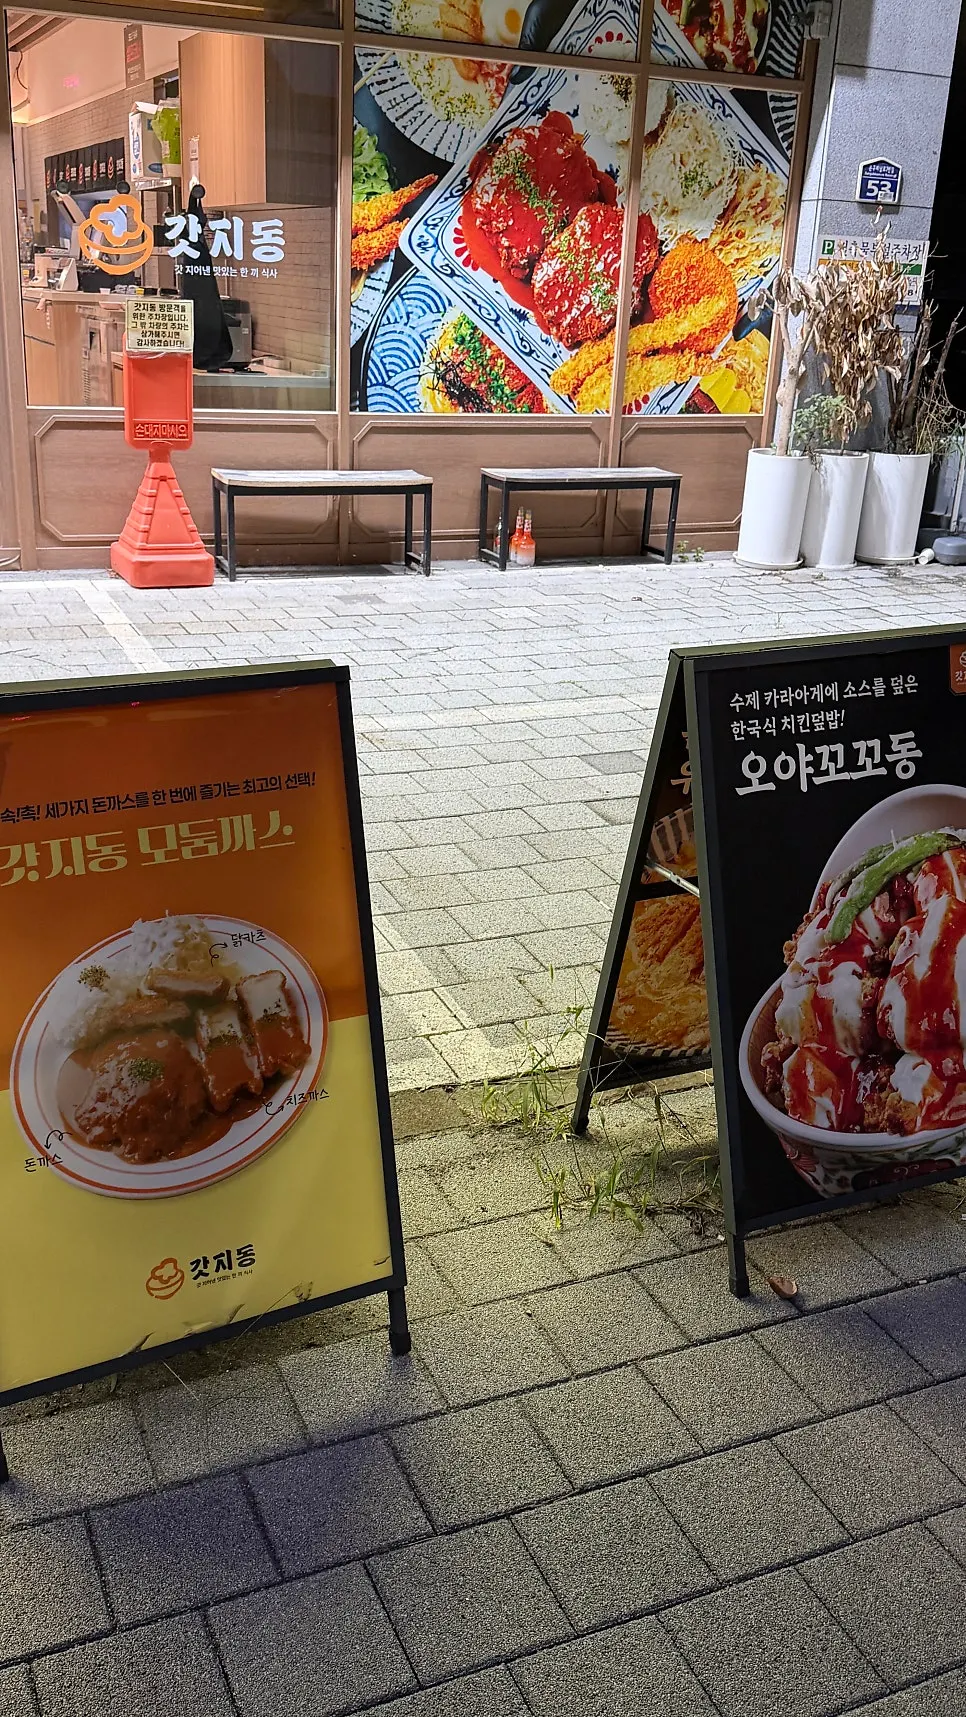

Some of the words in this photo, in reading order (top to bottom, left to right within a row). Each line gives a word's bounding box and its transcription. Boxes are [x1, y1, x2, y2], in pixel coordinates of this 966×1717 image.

[866, 180, 892, 197] 53
[164, 213, 286, 263] 갓지동
[174, 264, 183, 275] 갓
[185, 265, 211, 276] 지어낸
[213, 266, 238, 277] 맛있는
[240, 267, 249, 278] 한
[250, 267, 259, 278] 끼
[261, 268, 278, 279] 식사
[132, 312, 146, 320] 위한
[134, 303, 156, 312] 갓지동
[131, 321, 138, 329] 그
[149, 322, 168, 330] 차량의
[170, 323, 189, 331] 주차는
[135, 423, 188, 438] 손대지마시오
[730, 690, 760, 712] 수제
[764, 681, 839, 709] 카라아게에
[843, 677, 886, 698] 소스를
[890, 674, 918, 696] 덮은
[730, 716, 776, 741] 한국식
[781, 709, 845, 734] 치킨덮밥!
[735, 730, 923, 796] 오야꼬꼬동
[45, 798, 89, 819] 세가지
[92, 791, 150, 814] 돈까스를
[151, 789, 167, 806] 한
[169, 786, 197, 804] 번에
[200, 782, 241, 800] 즐기는
[243, 775, 282, 795] 최고의
[285, 772, 316, 790] 선택!
[0, 830, 128, 887] 갓지동
[137, 810, 296, 866] 모둠까스
[231, 929, 267, 947] 닭카츠
[286, 1089, 330, 1106] 치즈까스
[24, 1153, 63, 1172] 돈까스
[189, 1243, 256, 1281] 갓지동
